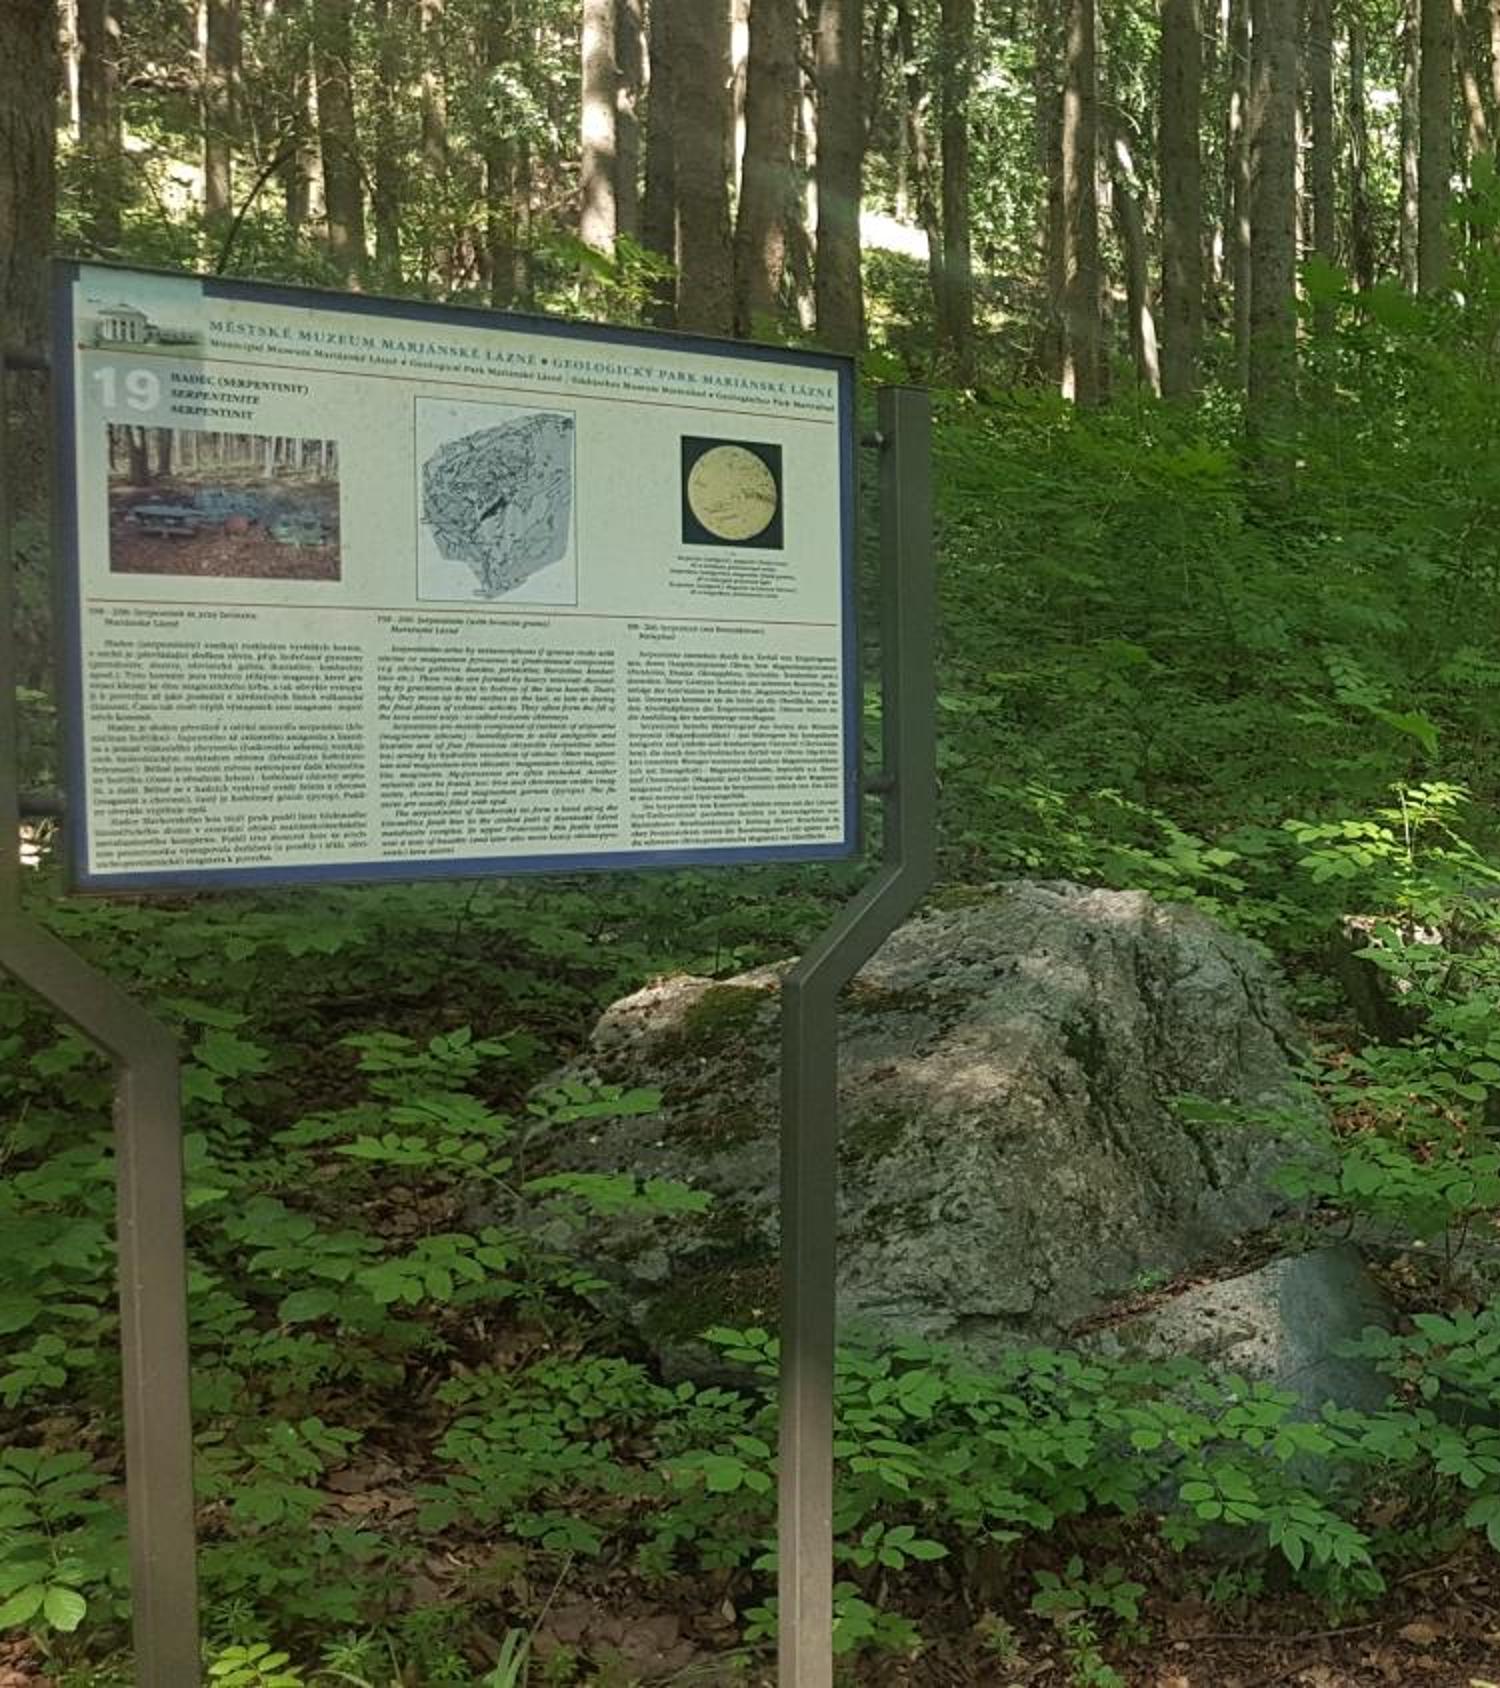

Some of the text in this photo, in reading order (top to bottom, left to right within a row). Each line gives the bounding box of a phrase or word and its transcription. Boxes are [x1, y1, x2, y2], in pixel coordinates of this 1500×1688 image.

[208, 319, 834, 399] MĚSTSKÉ MUZEUM MARIÁNSKÉ LÁZNĚ GEOLOGICKÝ PARK MARIÁNSKÉ LÁZNĚ
[210, 338, 265, 354] Municipal
[267, 344, 312, 357] Museum
[409, 358, 462, 373] Geological
[463, 363, 486, 375] Park
[92, 366, 161, 412] 19
[170, 388, 260, 405] SERPENTINITE
[217, 374, 310, 396] (SERPENTINIT)
[170, 404, 255, 420] SERPENTINIT
